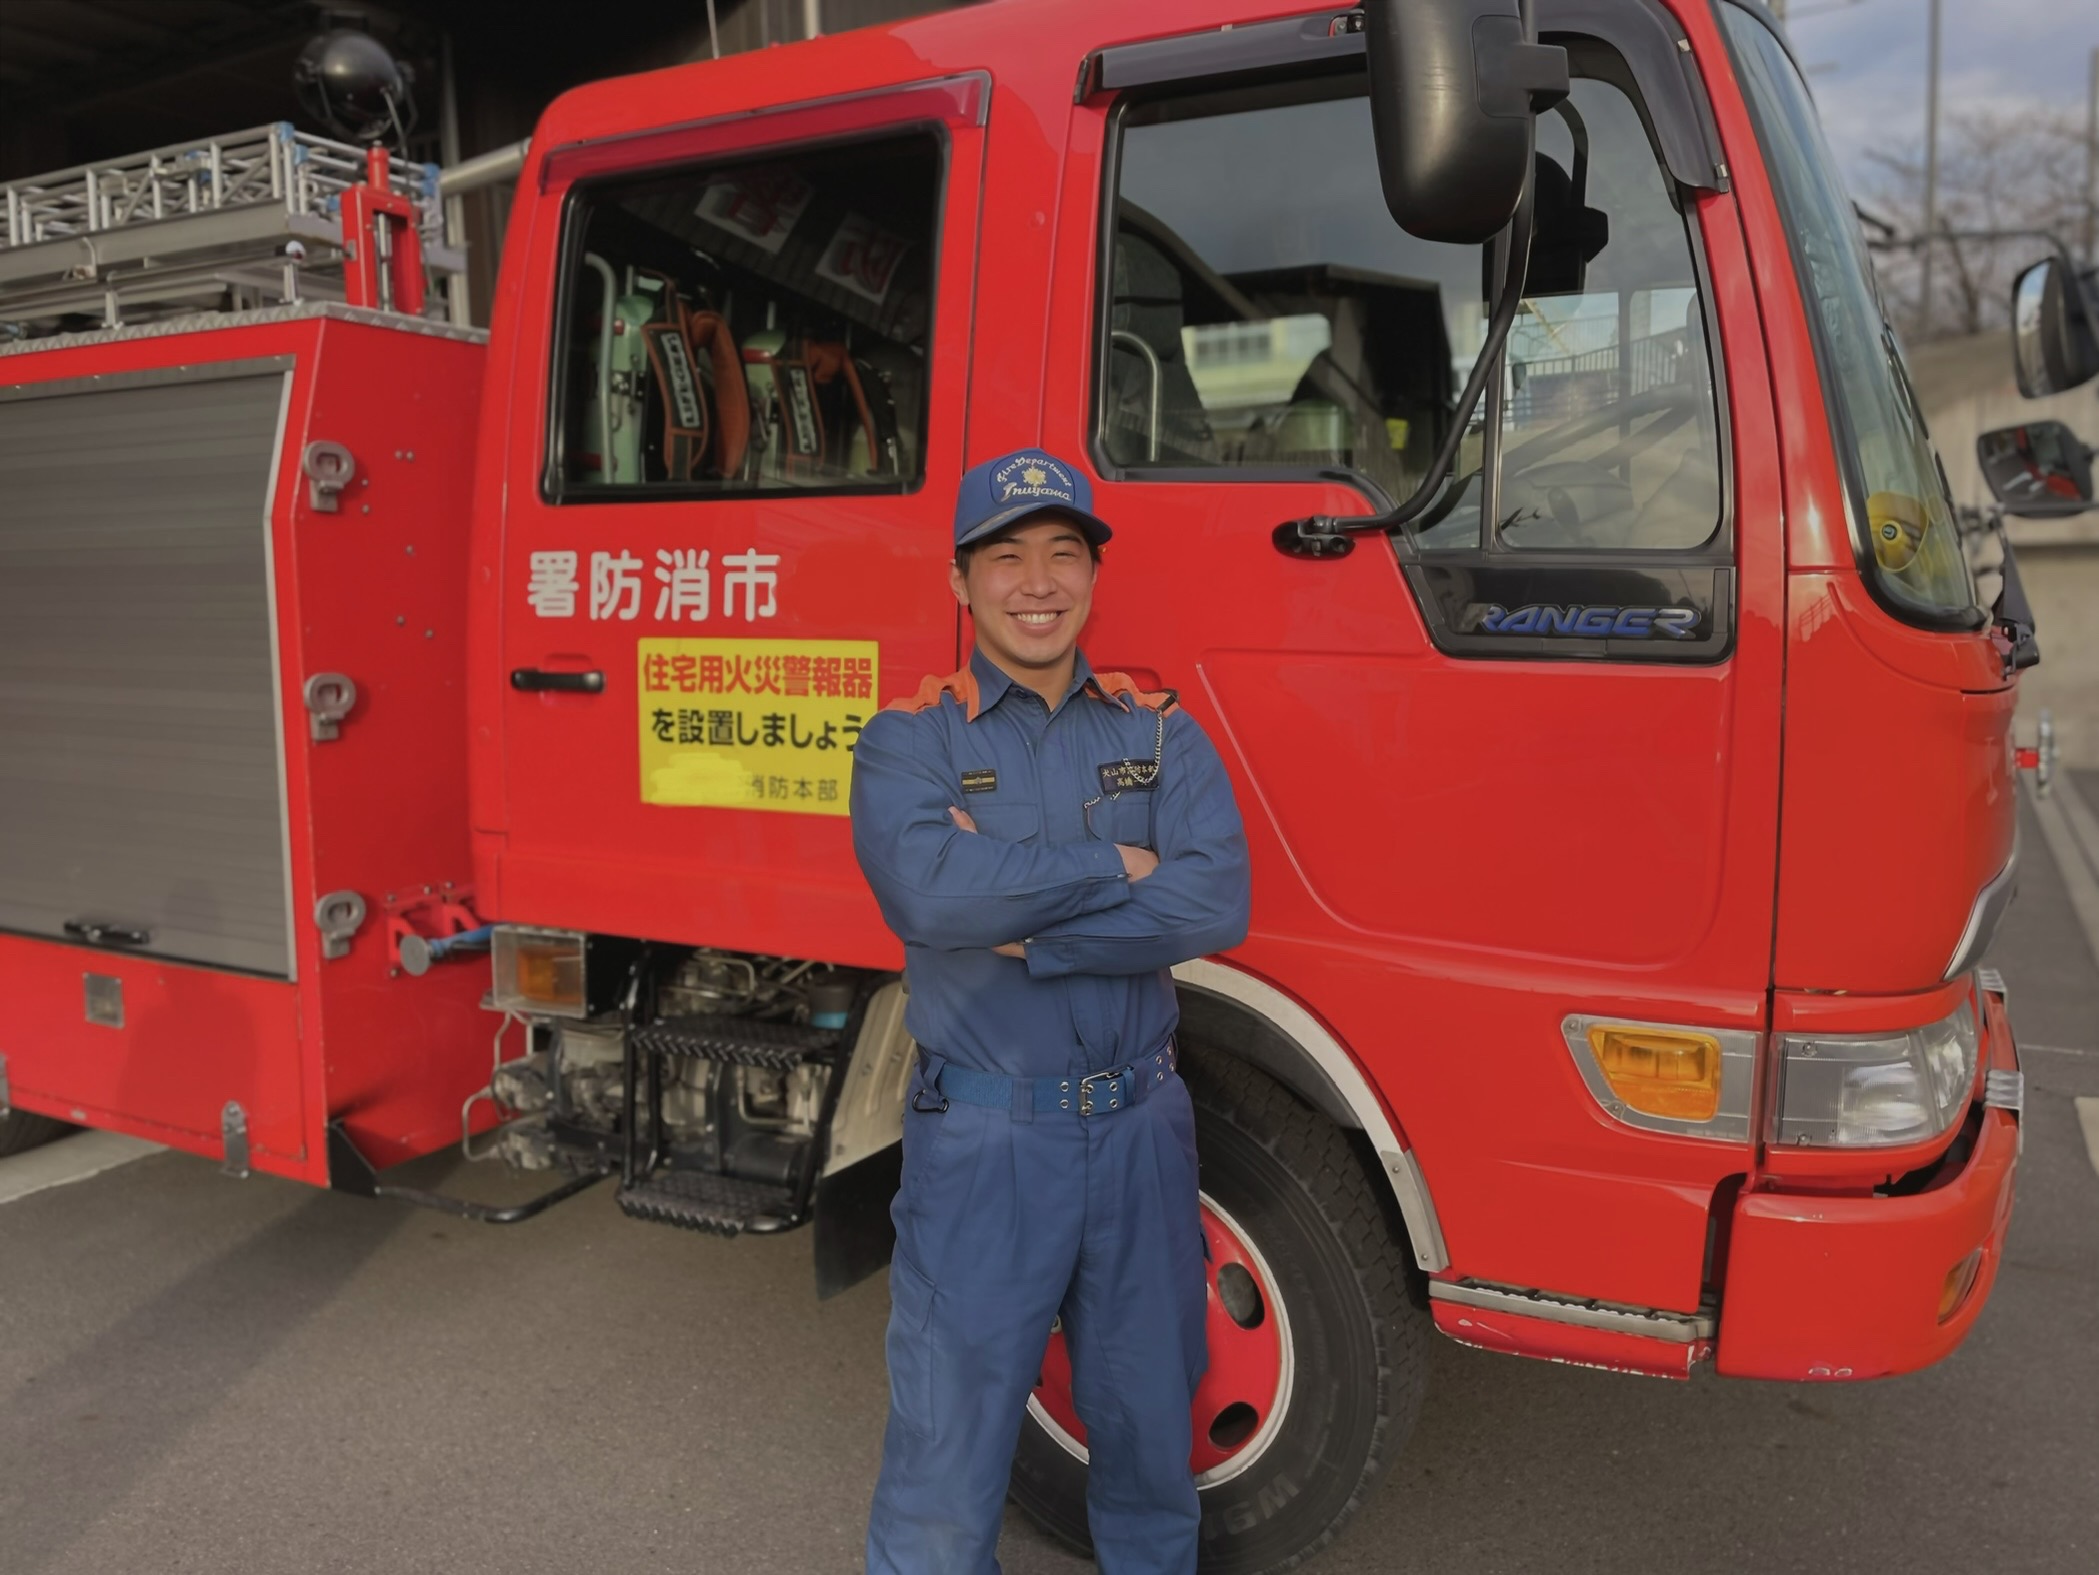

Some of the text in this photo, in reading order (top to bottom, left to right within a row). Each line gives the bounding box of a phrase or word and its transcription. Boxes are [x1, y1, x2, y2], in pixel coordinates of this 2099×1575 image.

[1001, 482, 1072, 502] Inuyama
[1466, 603, 1701, 639] RANGER
[642, 652, 873, 699] 住宅用火災警報器
[651, 707, 863, 752] を設置しましょう
